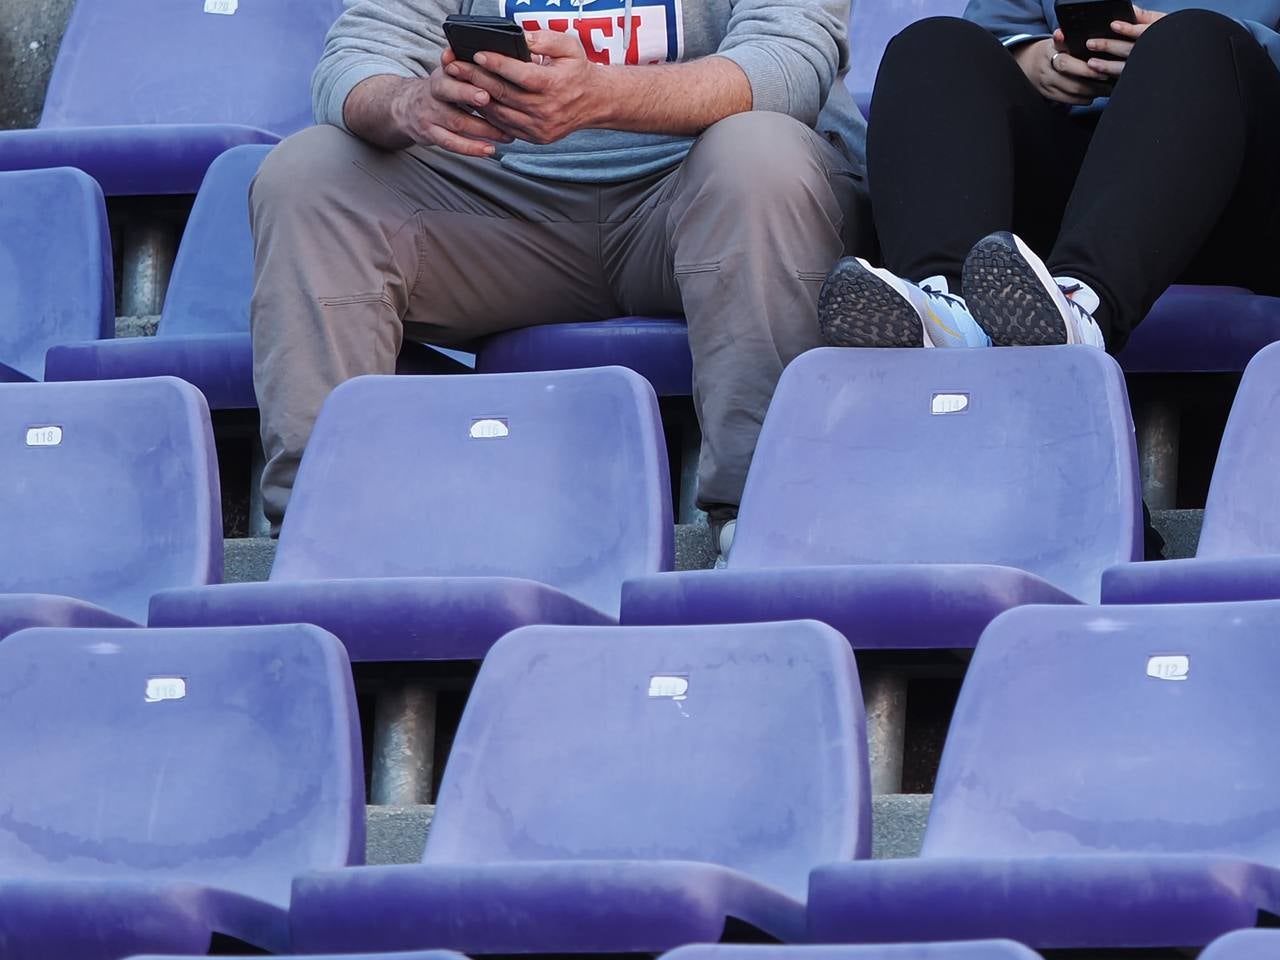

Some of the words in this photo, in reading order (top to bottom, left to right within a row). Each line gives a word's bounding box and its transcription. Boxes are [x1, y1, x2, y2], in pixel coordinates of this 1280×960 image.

[522, 16, 660, 66] FL
[34, 430, 54, 443] 118
[1157, 663, 1178, 676] 112
